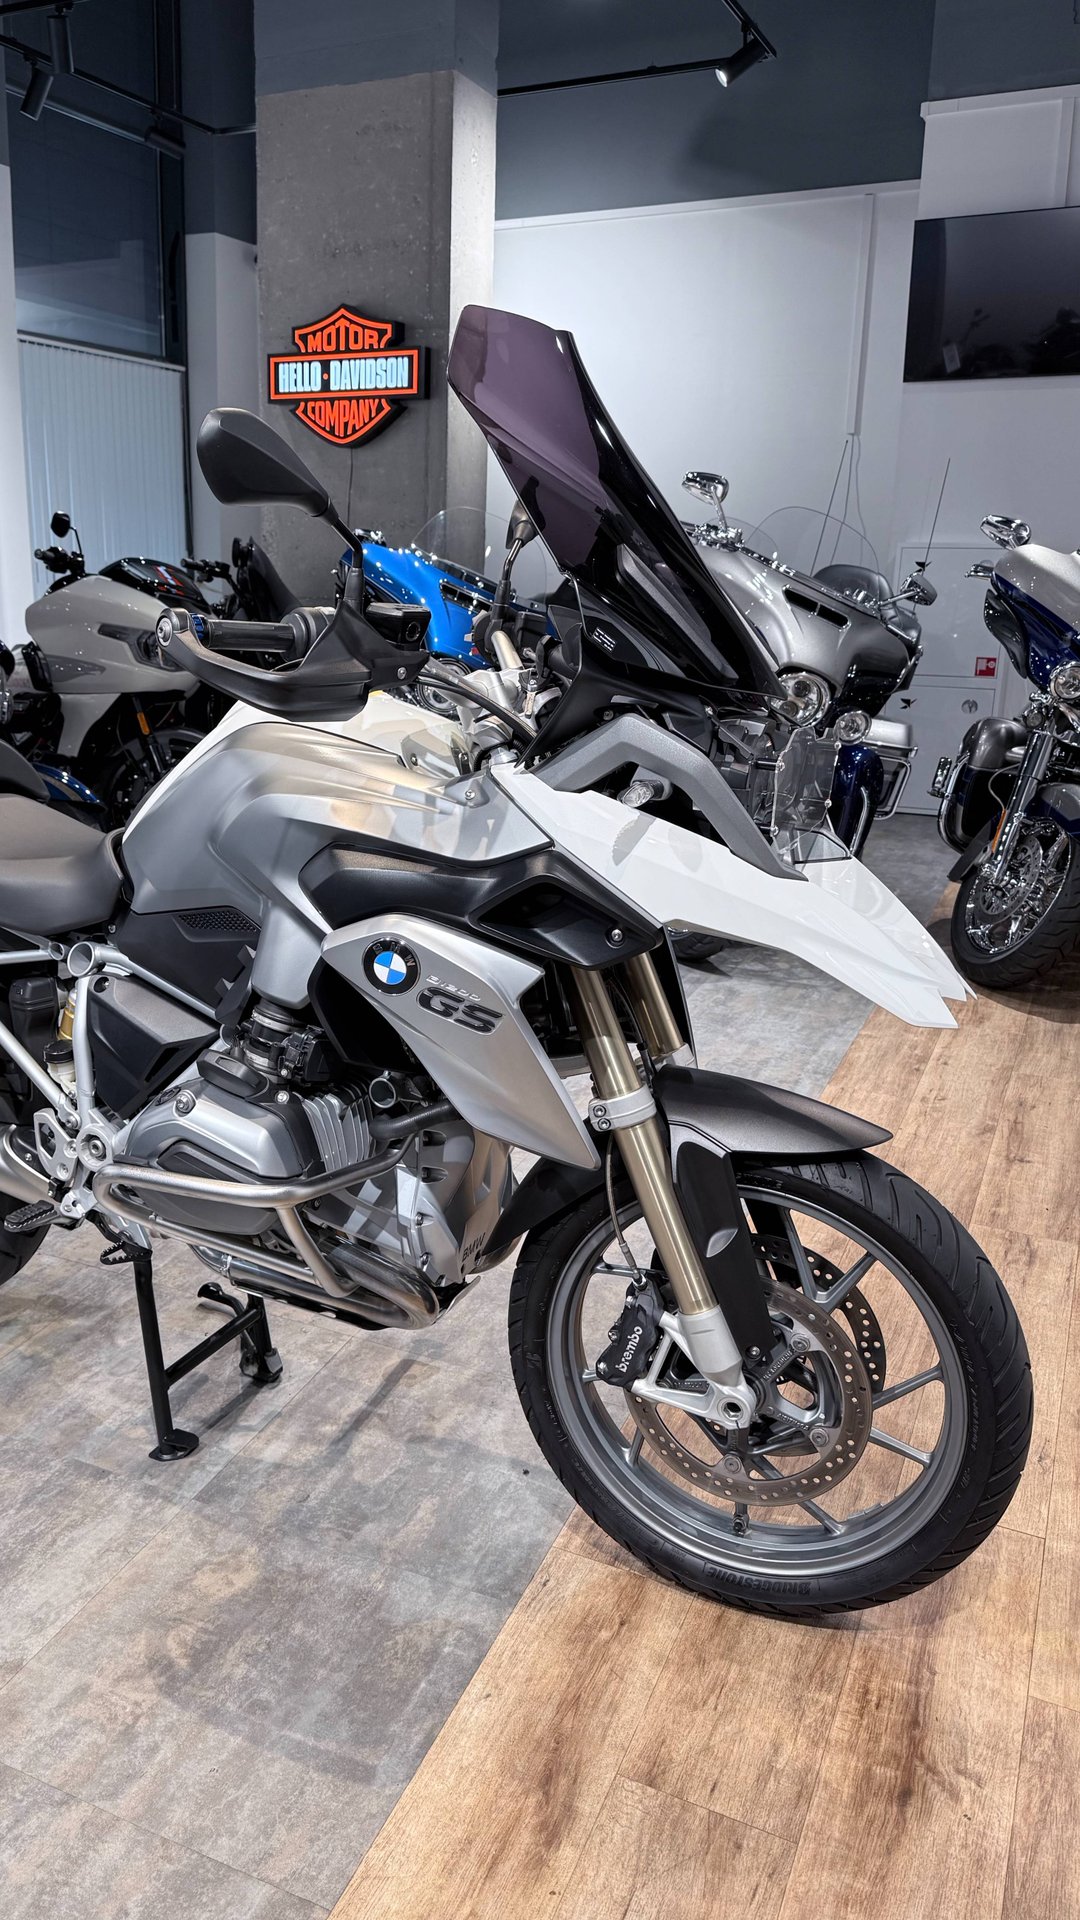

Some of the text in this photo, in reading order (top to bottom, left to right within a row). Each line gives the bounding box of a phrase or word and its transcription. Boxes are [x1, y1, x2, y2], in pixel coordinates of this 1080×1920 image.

[308, 318, 378, 352] MOTOR
[279, 356, 409, 393] HELLO DAVIDSON
[307, 399, 379, 436] COMPANY
[372, 943, 415, 967] BMW
[417, 987, 502, 1033] GS
[462, 1232, 485, 1262] BMW
[615, 1326, 643, 1373] brembo
[706, 1566, 812, 1596] BRIDGESTONE
